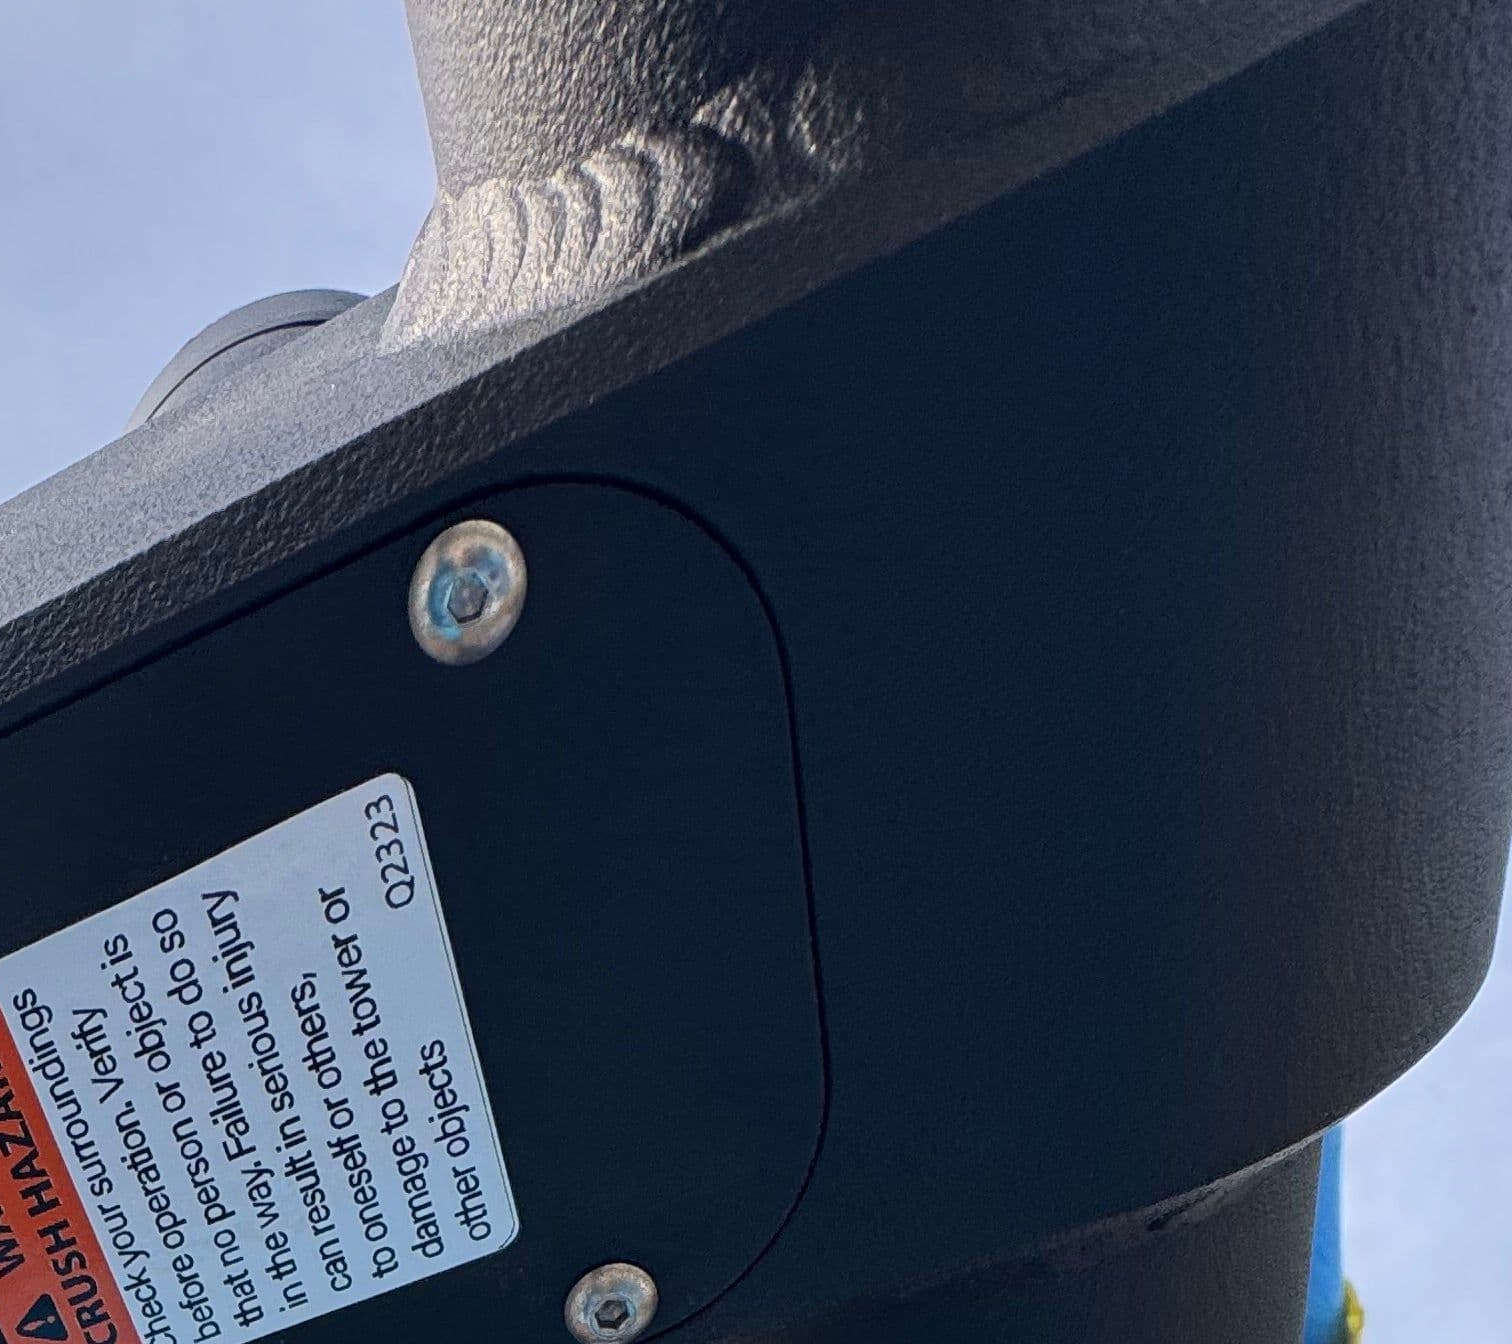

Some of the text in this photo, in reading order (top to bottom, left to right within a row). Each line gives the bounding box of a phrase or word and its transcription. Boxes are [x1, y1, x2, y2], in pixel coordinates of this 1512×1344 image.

[364, 794, 415, 909] Q2323
[12, 987, 113, 1196] surroundings
[70, 1007, 221, 1343] before operation. Verify
[100, 933, 264, 1327] that no person or object is
[151, 908, 308, 1312] in the way. Failure to do so
[200, 890, 352, 1291] can result in serious injury
[290, 972, 398, 1278] to oneself or others,
[317, 886, 444, 1258] damage to the tower or
[418, 1039, 491, 1241] other objects
[96, 1204, 150, 1268] your
